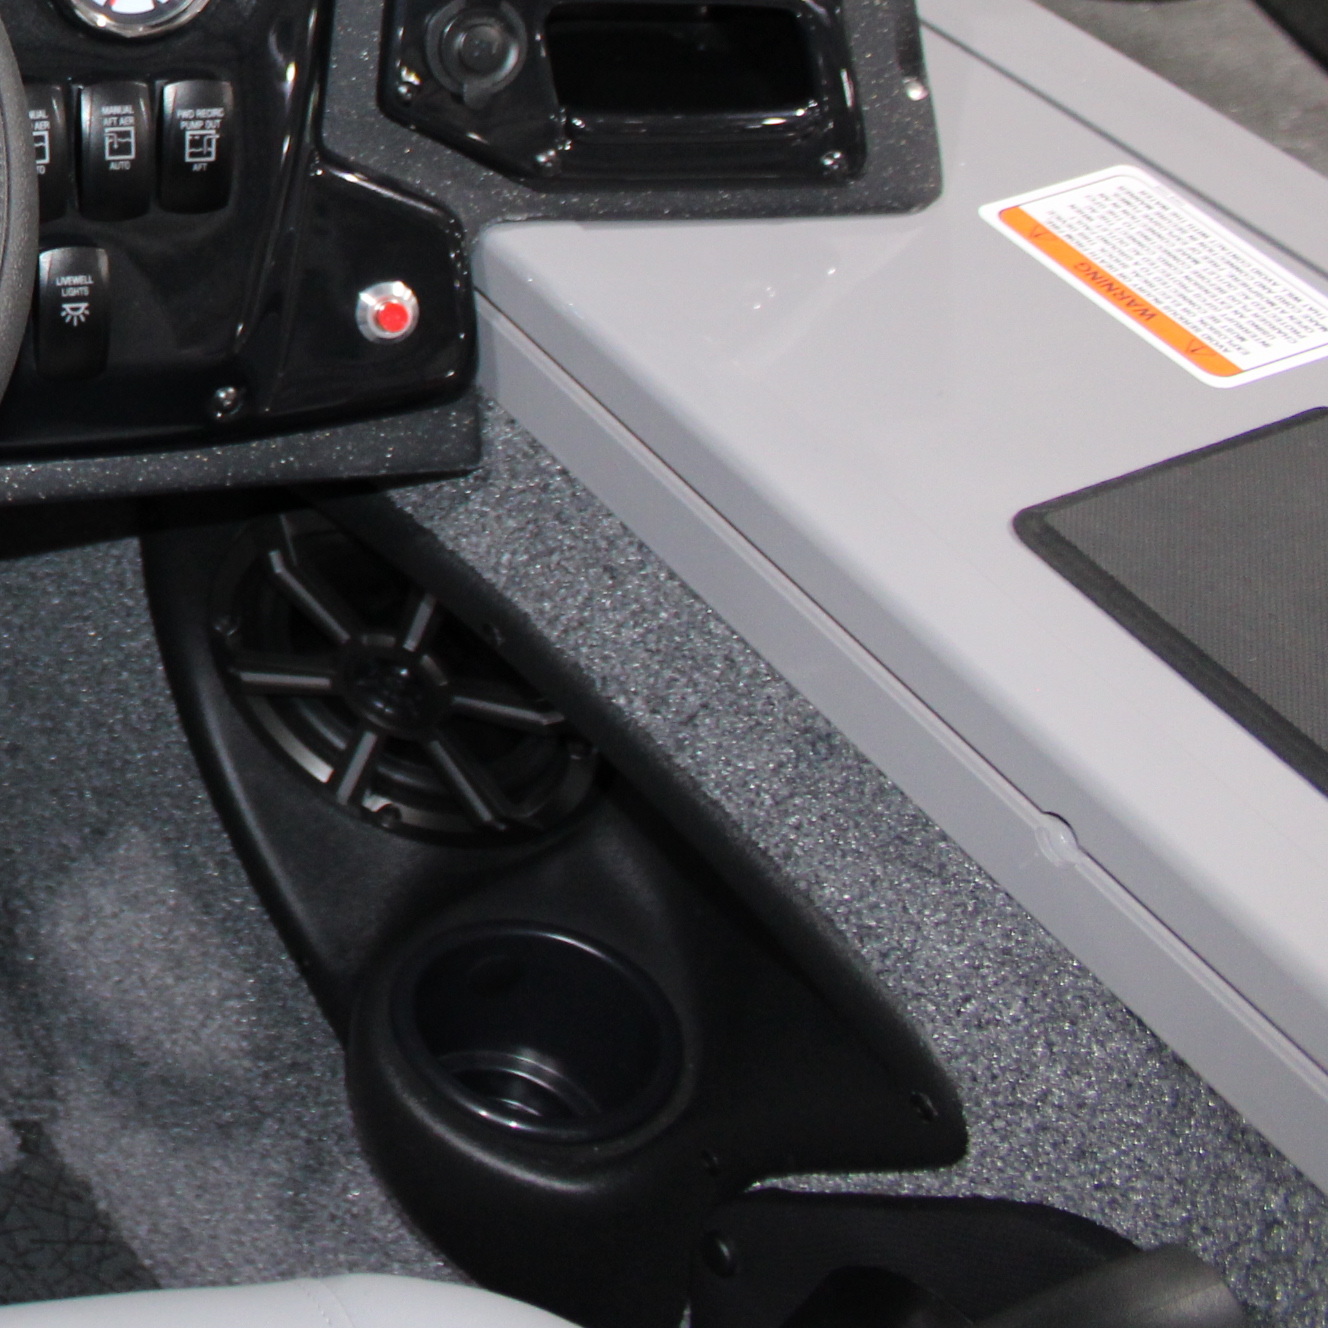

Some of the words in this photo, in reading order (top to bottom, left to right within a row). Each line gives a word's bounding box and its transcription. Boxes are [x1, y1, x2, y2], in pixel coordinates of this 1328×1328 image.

[101, 105, 135, 116] MANUAL
[109, 160, 132, 171] AUTO
[192, 162, 208, 172] AFT
[56, 274, 94, 286] LIVEWELL
[61, 286, 90, 297] LIGHTS
[1071, 262, 1158, 320] WARNING
